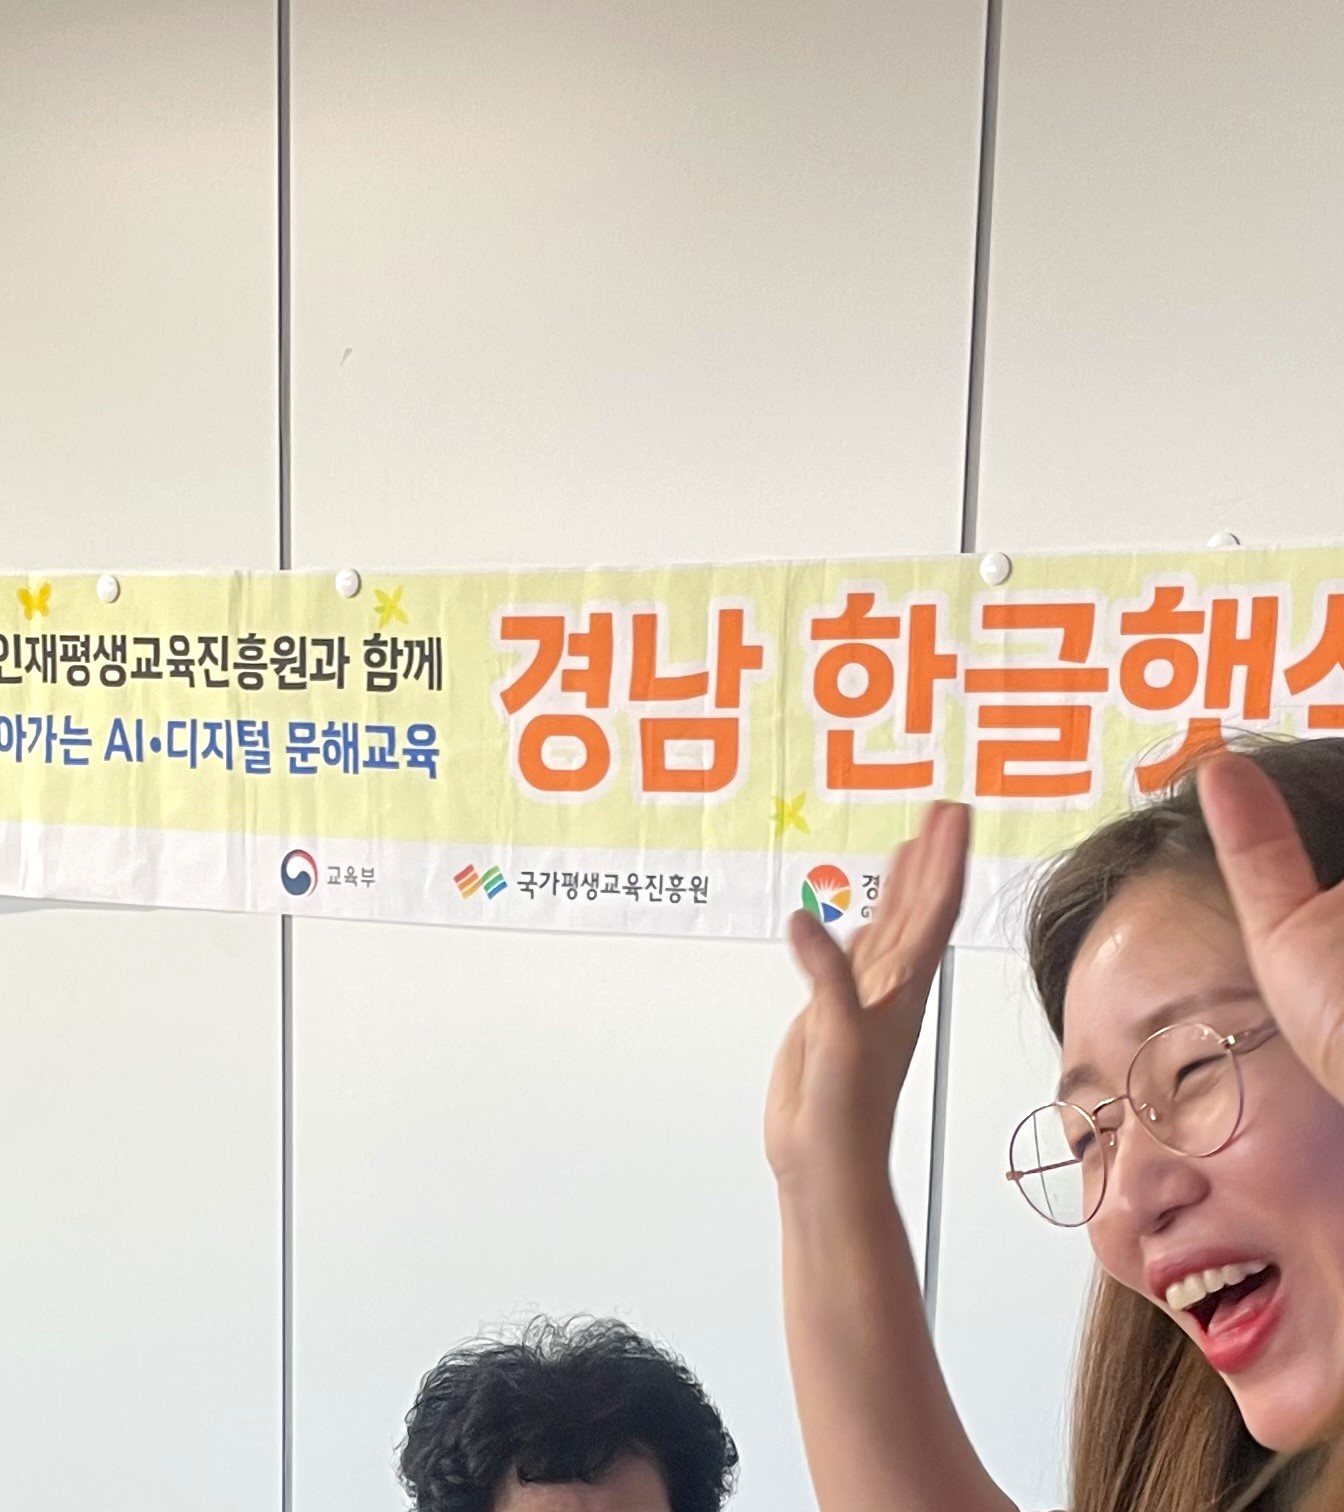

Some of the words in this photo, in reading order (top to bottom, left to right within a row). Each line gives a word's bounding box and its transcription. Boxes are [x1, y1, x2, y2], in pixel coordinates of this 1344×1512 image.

[363, 632, 444, 693] 함께
[498, 609, 764, 792] 경남
[285, 720, 440, 779] 문해교육
[326, 864, 376, 889] 교육부
[516, 869, 709, 905] 국가평생교육진흥원
